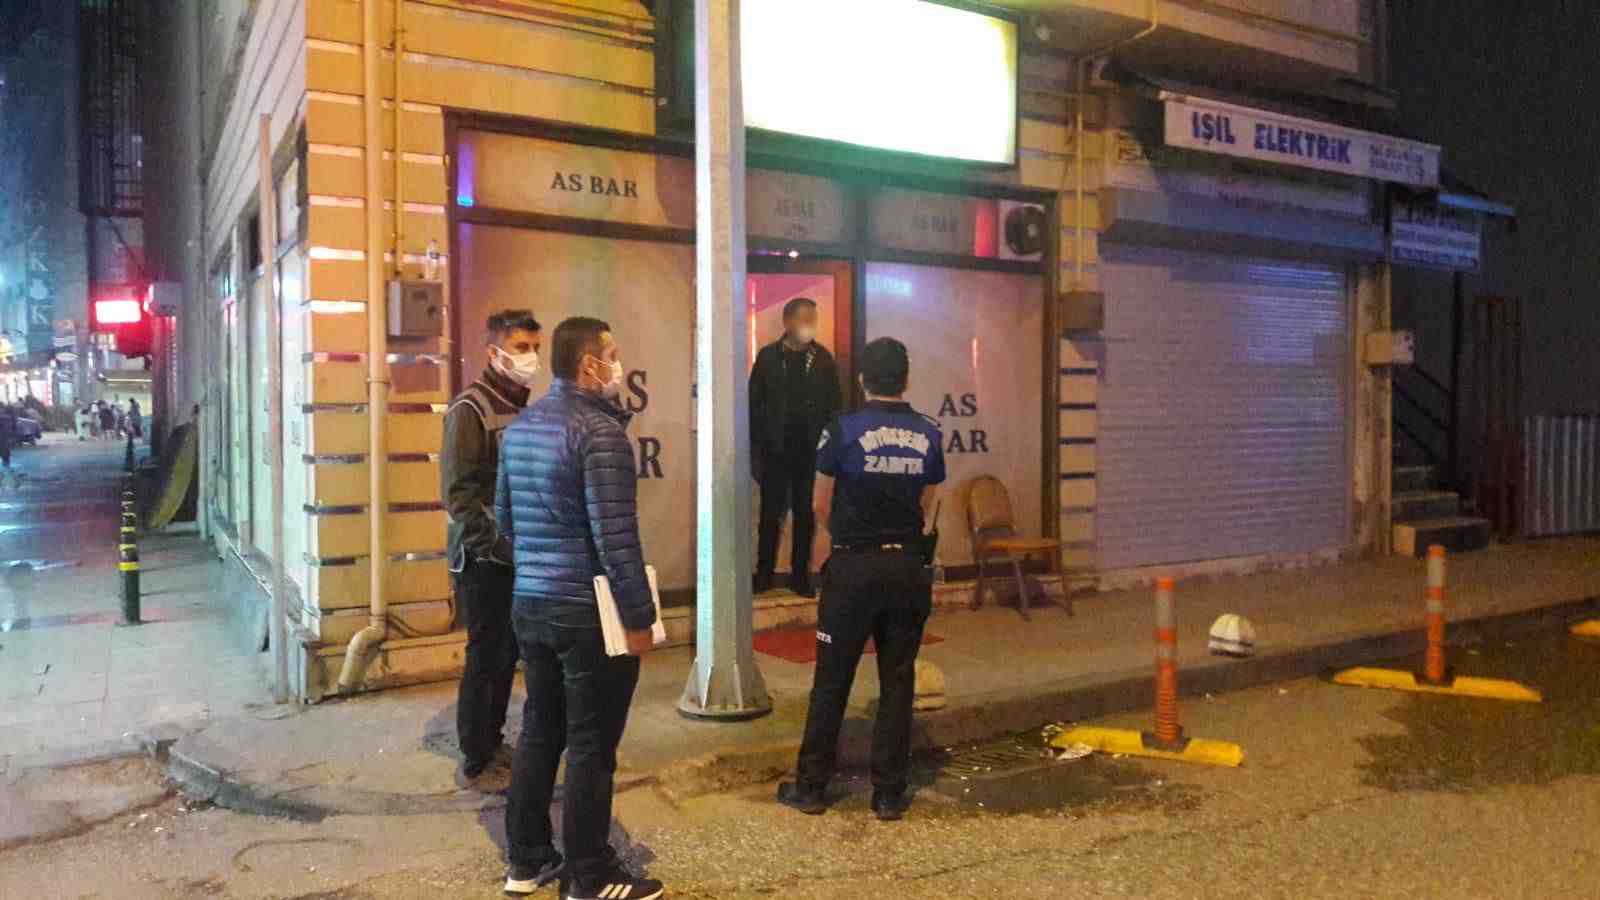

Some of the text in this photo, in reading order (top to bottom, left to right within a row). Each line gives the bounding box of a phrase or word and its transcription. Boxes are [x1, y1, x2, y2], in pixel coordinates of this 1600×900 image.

[550, 171, 639, 198] AS BAR
[938, 393, 977, 417] AS
[946, 429, 989, 453] AR
